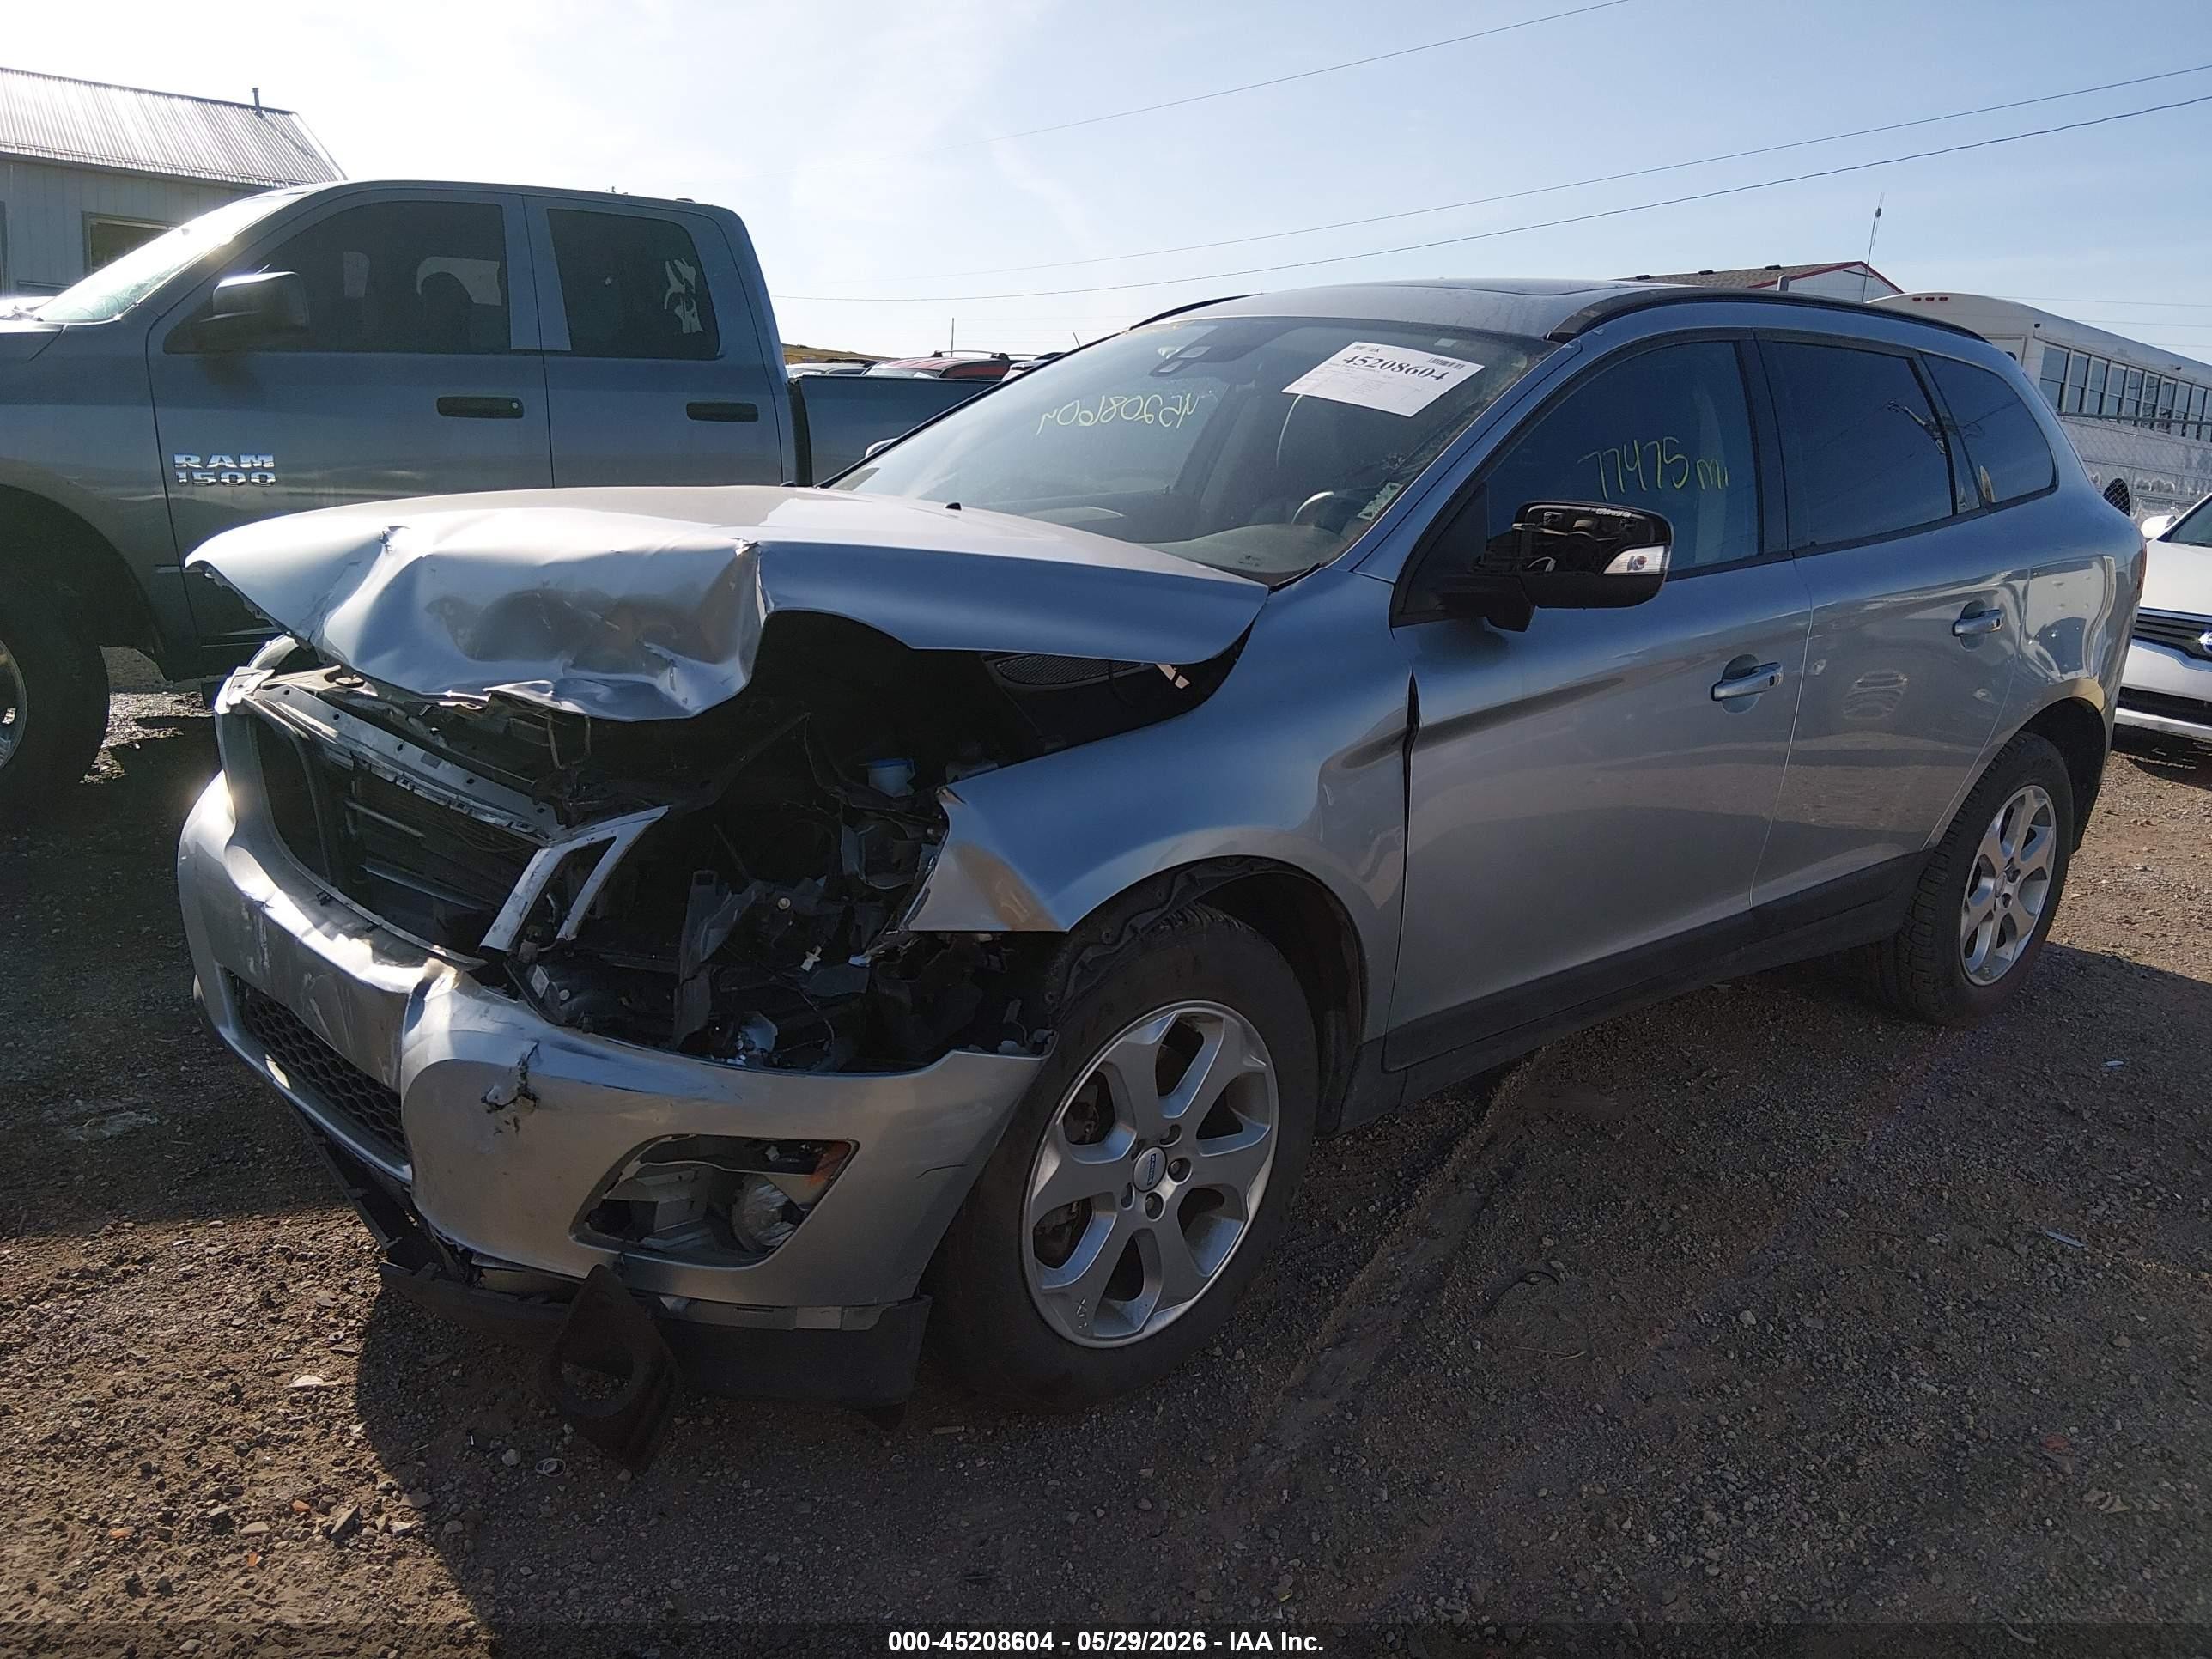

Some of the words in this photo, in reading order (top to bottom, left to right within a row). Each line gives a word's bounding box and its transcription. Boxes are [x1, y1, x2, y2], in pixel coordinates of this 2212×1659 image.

[1342, 354, 1450, 381] 45208604
[173, 453, 276, 468] RAM
[1577, 436, 1690, 501] 77475
[175, 471, 276, 487] 1500
